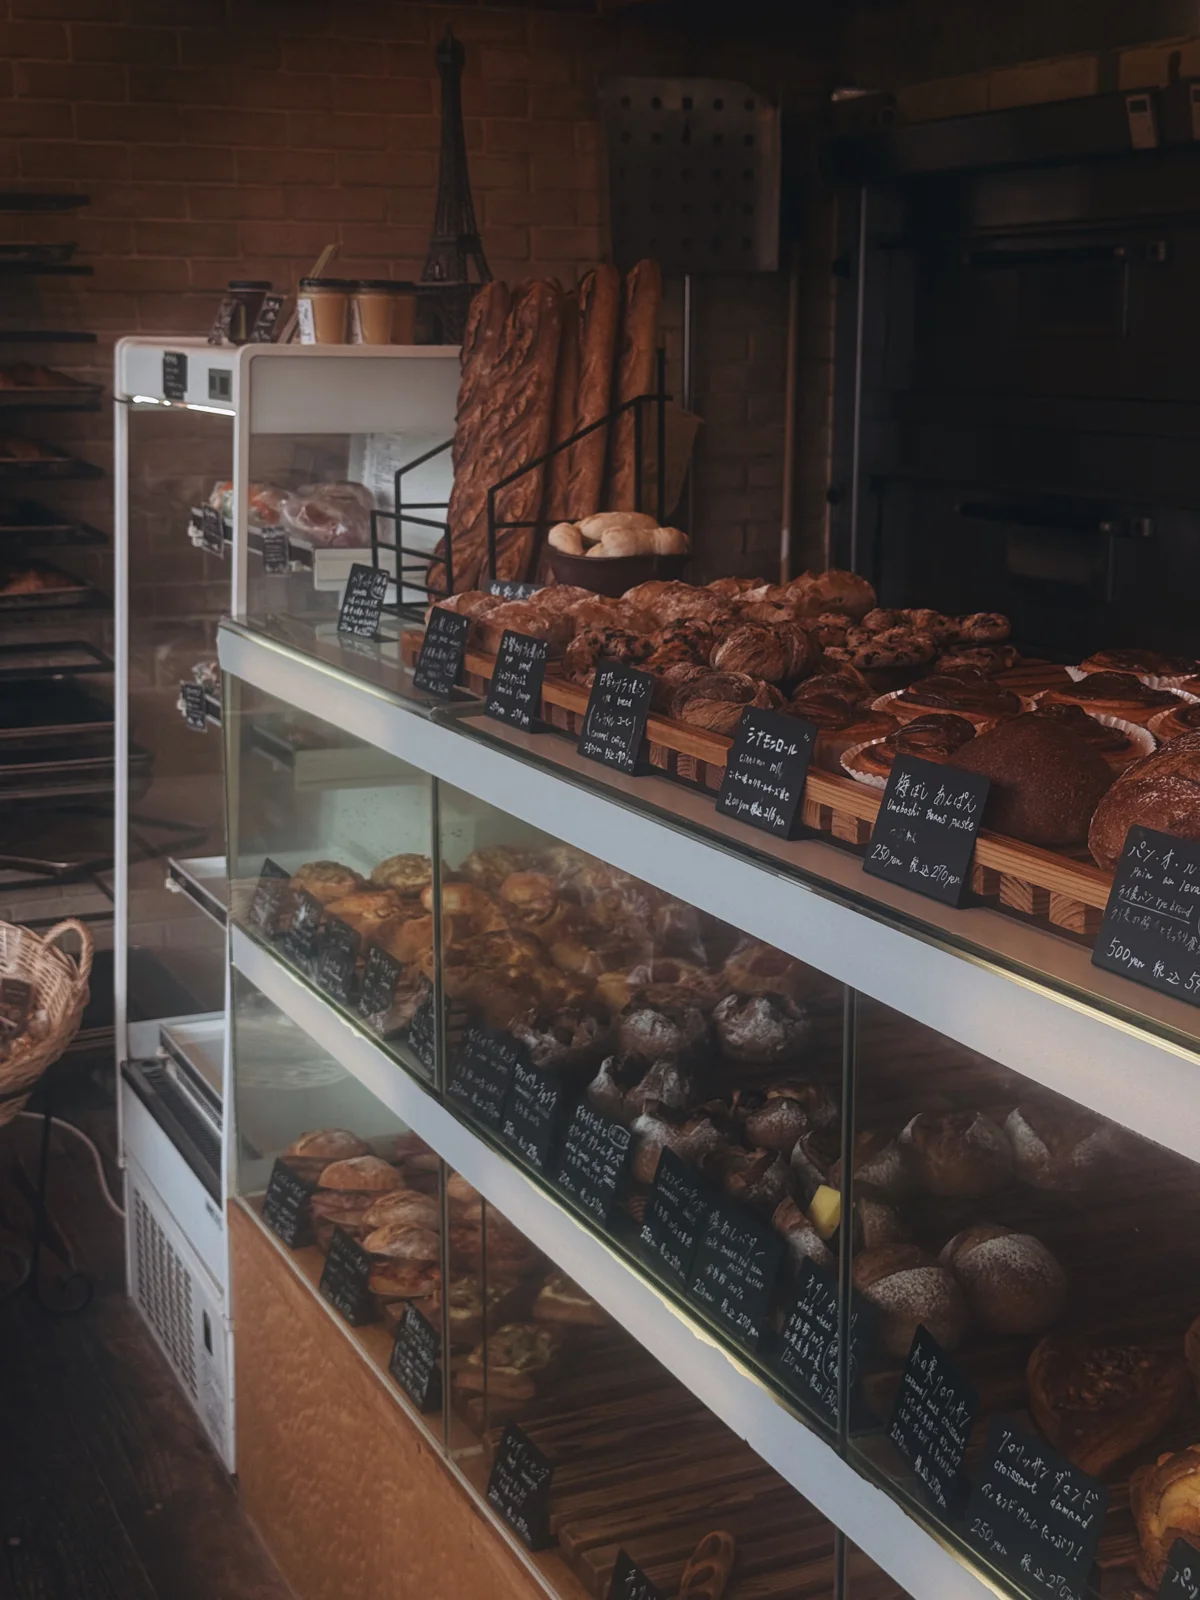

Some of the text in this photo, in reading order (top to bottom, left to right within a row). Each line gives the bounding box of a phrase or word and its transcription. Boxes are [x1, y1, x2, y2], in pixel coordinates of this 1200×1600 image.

[887, 798, 921, 816] Umeboshi
[871, 844, 902, 867] 250yen
[1156, 897, 1168, 910] rye
[1107, 936, 1145, 969] 500yen
[994, 1459, 1039, 1495] croissant
